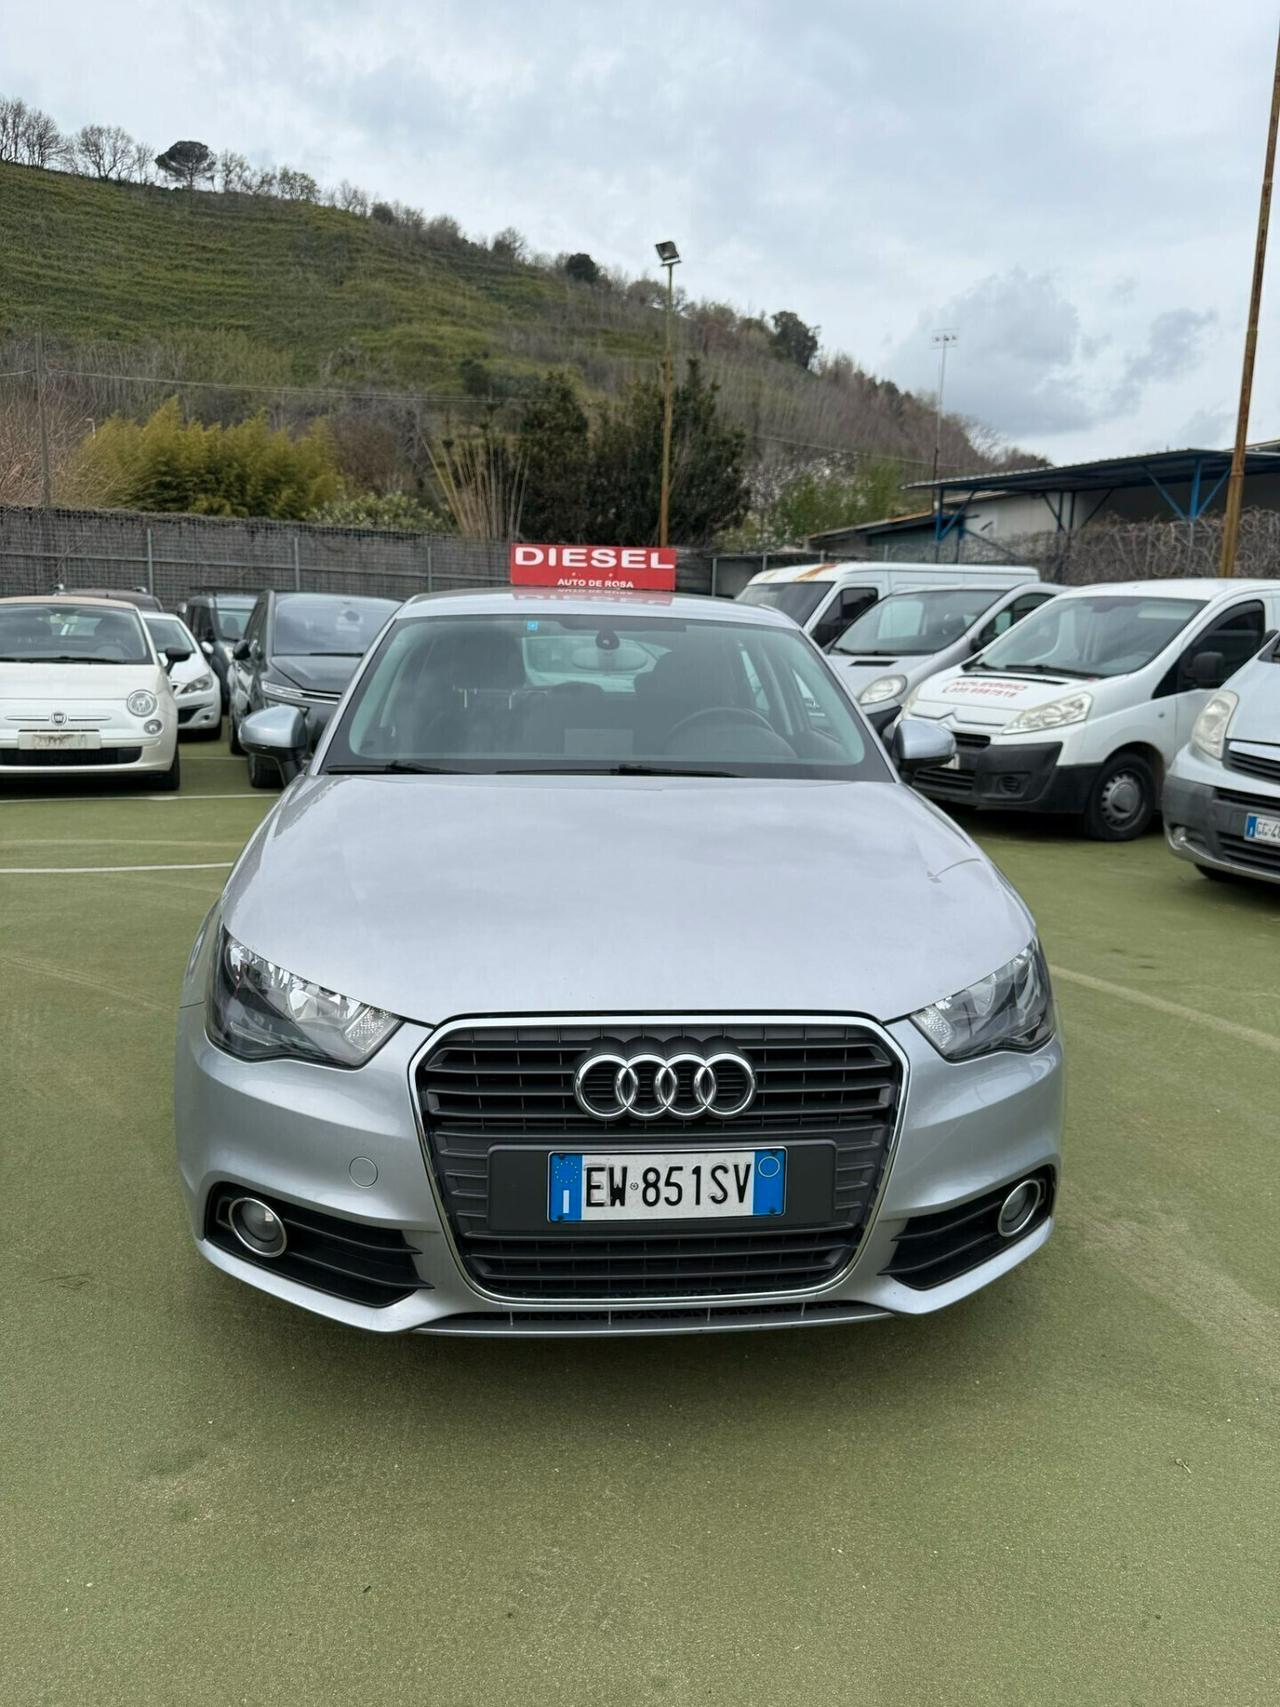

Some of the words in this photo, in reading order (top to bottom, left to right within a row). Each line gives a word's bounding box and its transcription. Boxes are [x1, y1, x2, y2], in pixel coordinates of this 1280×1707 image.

[515, 547, 674, 569] DIESEL
[557, 578, 586, 588] AUTO
[588, 579, 602, 588] DE
[605, 580, 634, 589] ROSA
